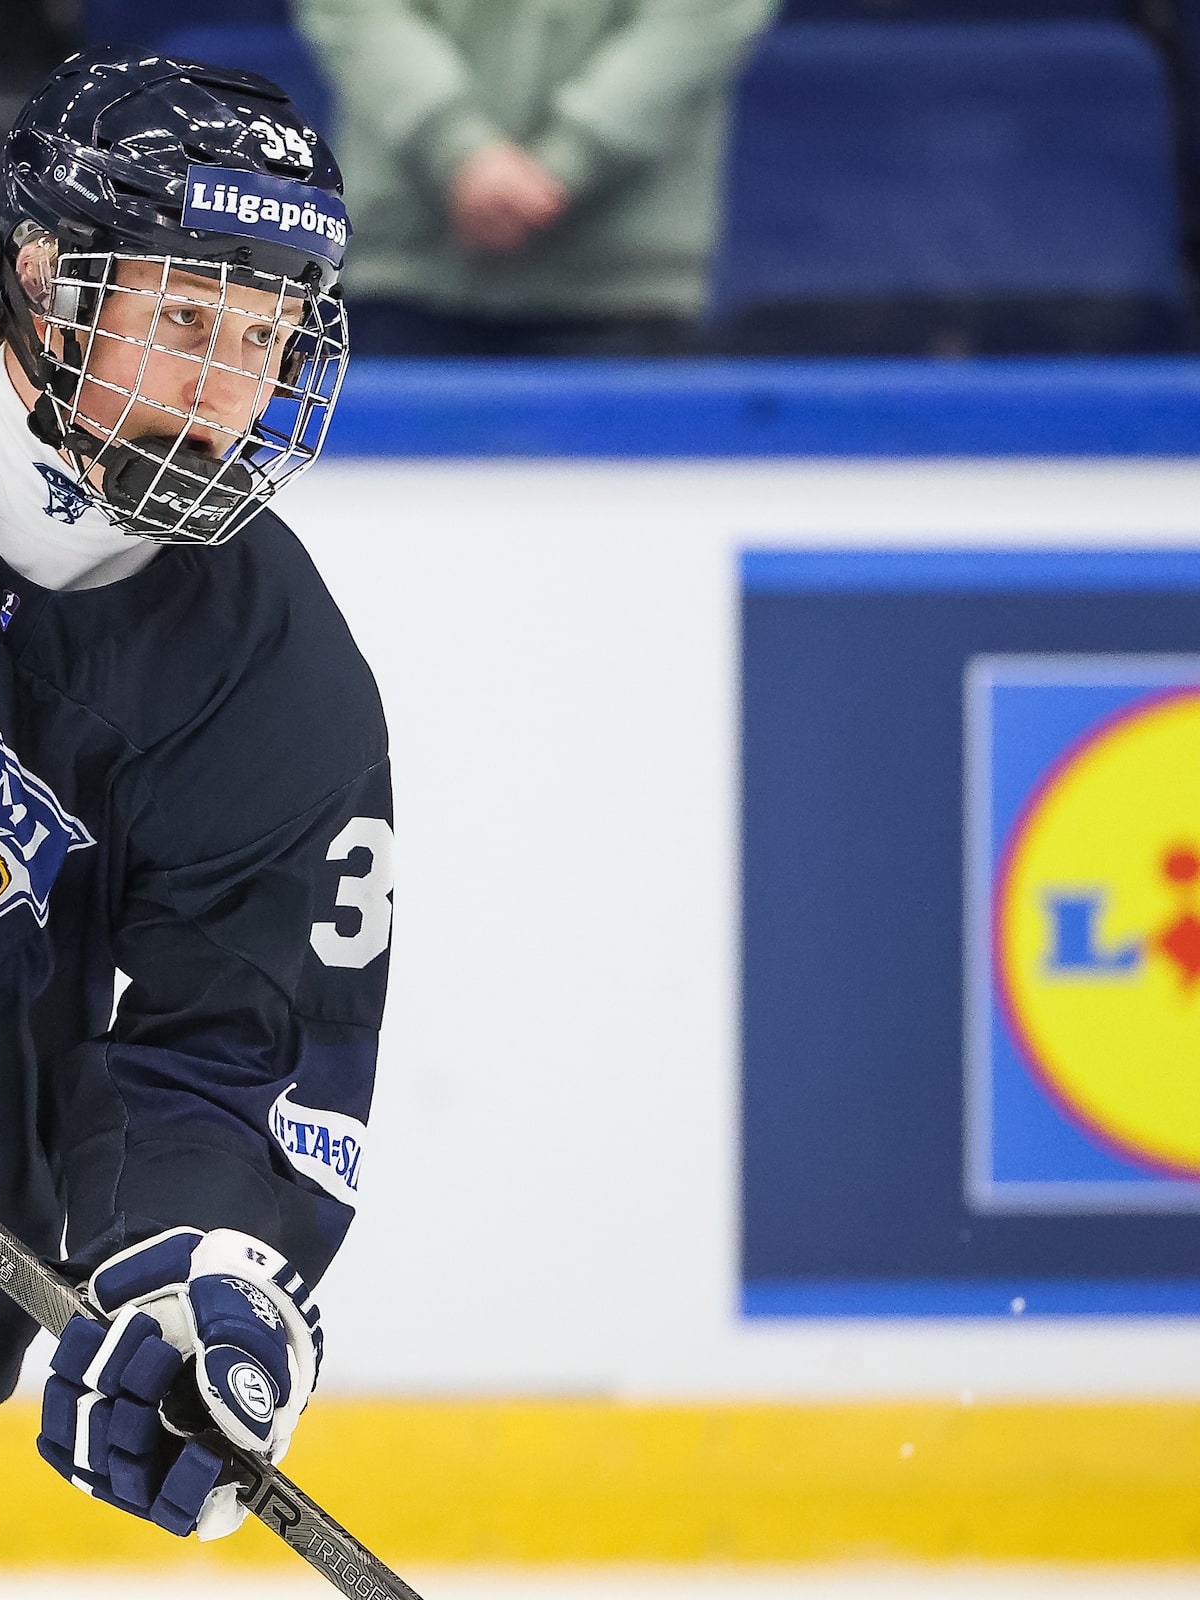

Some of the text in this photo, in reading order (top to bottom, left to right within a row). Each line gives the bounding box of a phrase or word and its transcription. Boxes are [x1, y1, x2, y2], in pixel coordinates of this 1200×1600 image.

[249, 120, 314, 168] 34
[189, 182, 347, 247] Liigapörssi
[307, 1528, 398, 1600] TRIGGE
